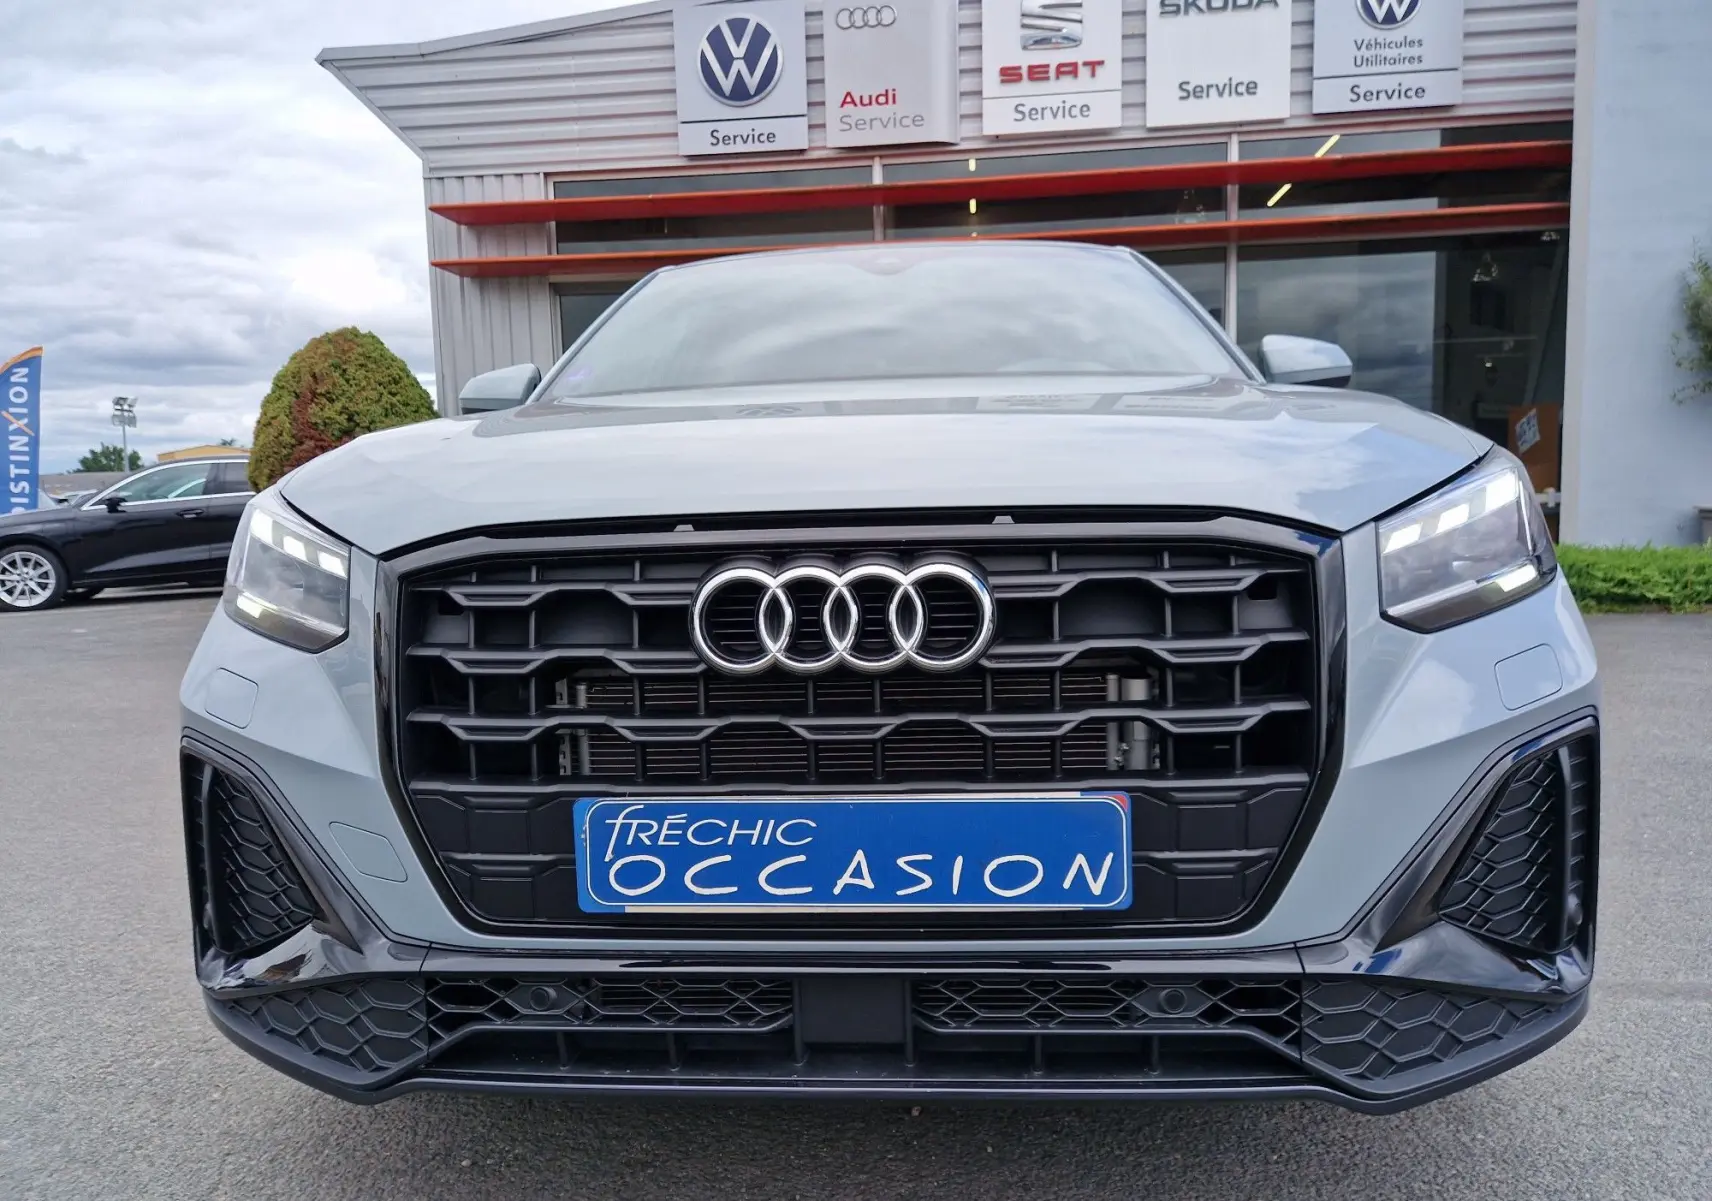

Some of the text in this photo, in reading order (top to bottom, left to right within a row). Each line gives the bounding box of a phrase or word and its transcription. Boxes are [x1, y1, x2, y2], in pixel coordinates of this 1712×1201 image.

[1354, 36, 1424, 51] Véhicules
[1354, 52, 1423, 68] Utilitaires
[999, 59, 1105, 84] SEAT
[839, 89, 897, 109] Audi
[1178, 77, 1258, 101] Service
[1349, 83, 1426, 103] Service
[1013, 100, 1091, 122] Service
[839, 112, 926, 133] Service
[709, 128, 777, 147] Service
[608, 848, 1115, 897] OCCASION
